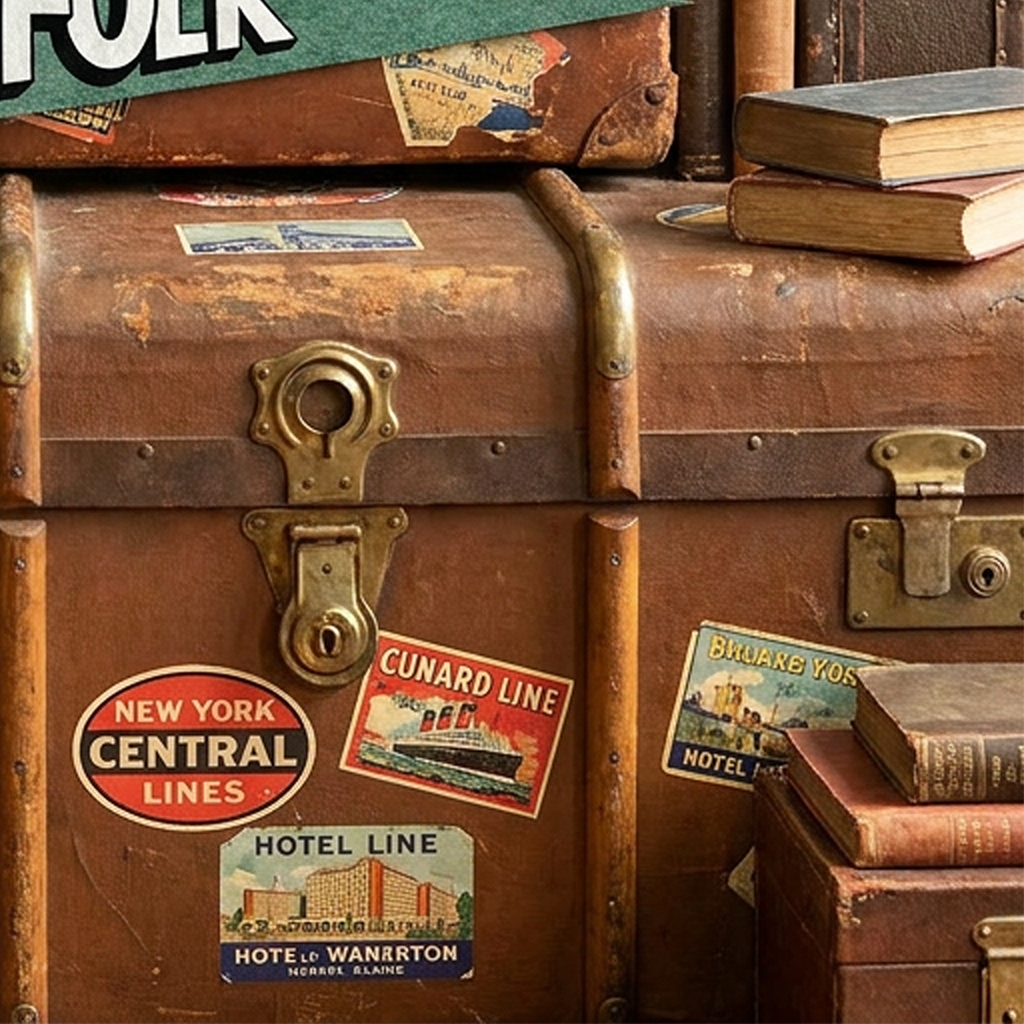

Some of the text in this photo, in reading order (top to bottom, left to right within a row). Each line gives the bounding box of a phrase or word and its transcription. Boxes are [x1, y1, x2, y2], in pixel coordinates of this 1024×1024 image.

[379, 647, 559, 715] CUNARD LINE
[115, 698, 275, 723] NEW YORK
[89, 734, 297, 769] CENTRAL
[143, 779, 245, 804] LINES
[255, 833, 438, 856] HOTEL LINE
